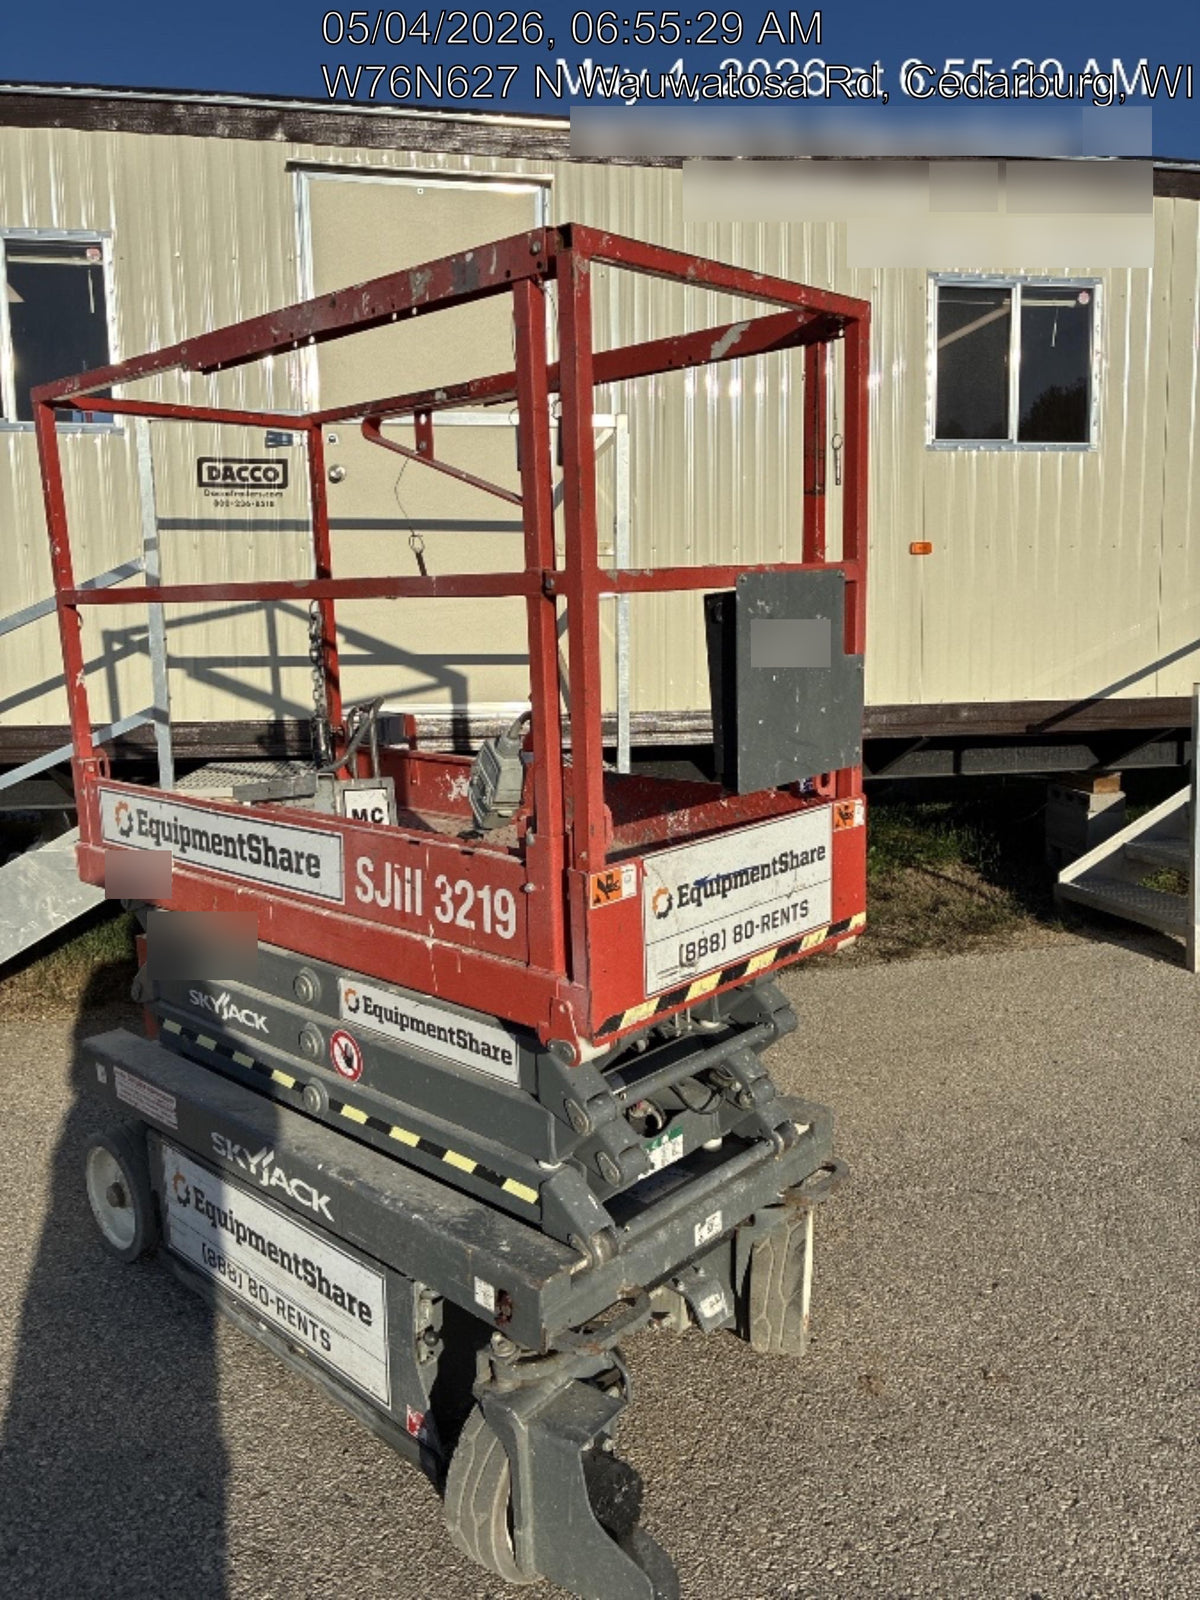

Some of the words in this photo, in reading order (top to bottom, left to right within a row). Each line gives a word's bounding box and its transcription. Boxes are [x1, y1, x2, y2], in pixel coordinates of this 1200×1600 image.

[207, 465, 279, 482] DACCO
[136, 808, 321, 878] EquipmentShare
[677, 845, 826, 908] EquipmentShare
[435, 874, 516, 940] 3219
[678, 928, 726, 969] (888)
[733, 899, 809, 944] 80-RENTS
[189, 991, 270, 1033] SKYJACK
[362, 995, 513, 1066] EquipmentShare
[210, 1131, 335, 1222] SKYJACK
[193, 1185, 373, 1327] EquipmentShare
[201, 1242, 243, 1290] (888)
[248, 1276, 332, 1352] 80-RENTS
